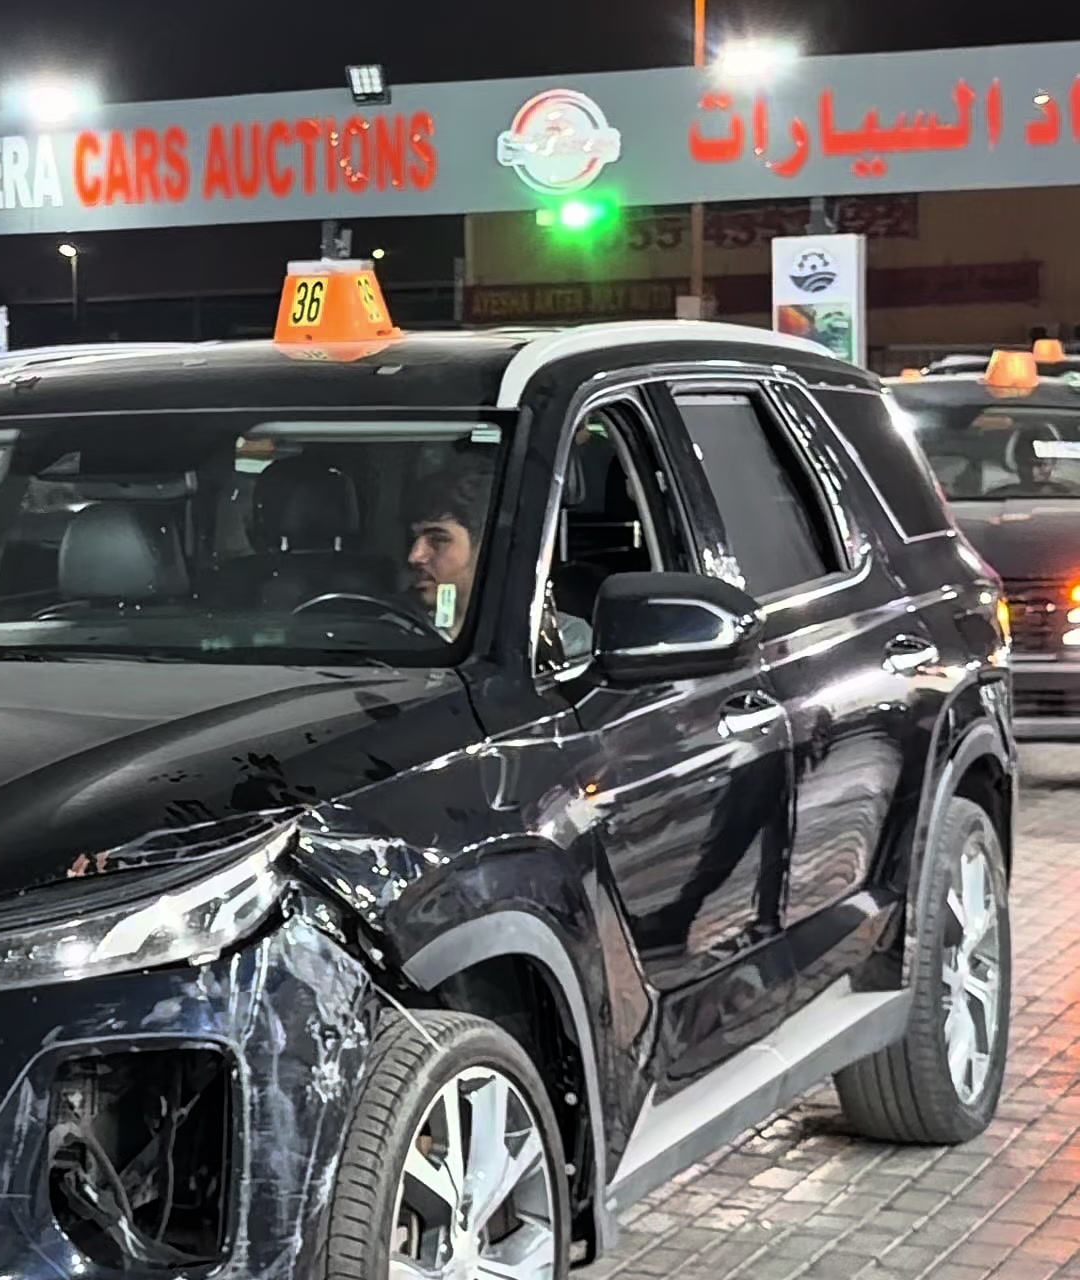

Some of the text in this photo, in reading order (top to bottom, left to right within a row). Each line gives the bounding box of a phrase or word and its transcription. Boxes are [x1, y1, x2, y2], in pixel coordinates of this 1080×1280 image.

[73, 124, 189, 207] CARS
[201, 110, 436, 201] AUCTIONS
[689, 77, 1002, 179] السيارات
[291, 280, 324, 324] 36
